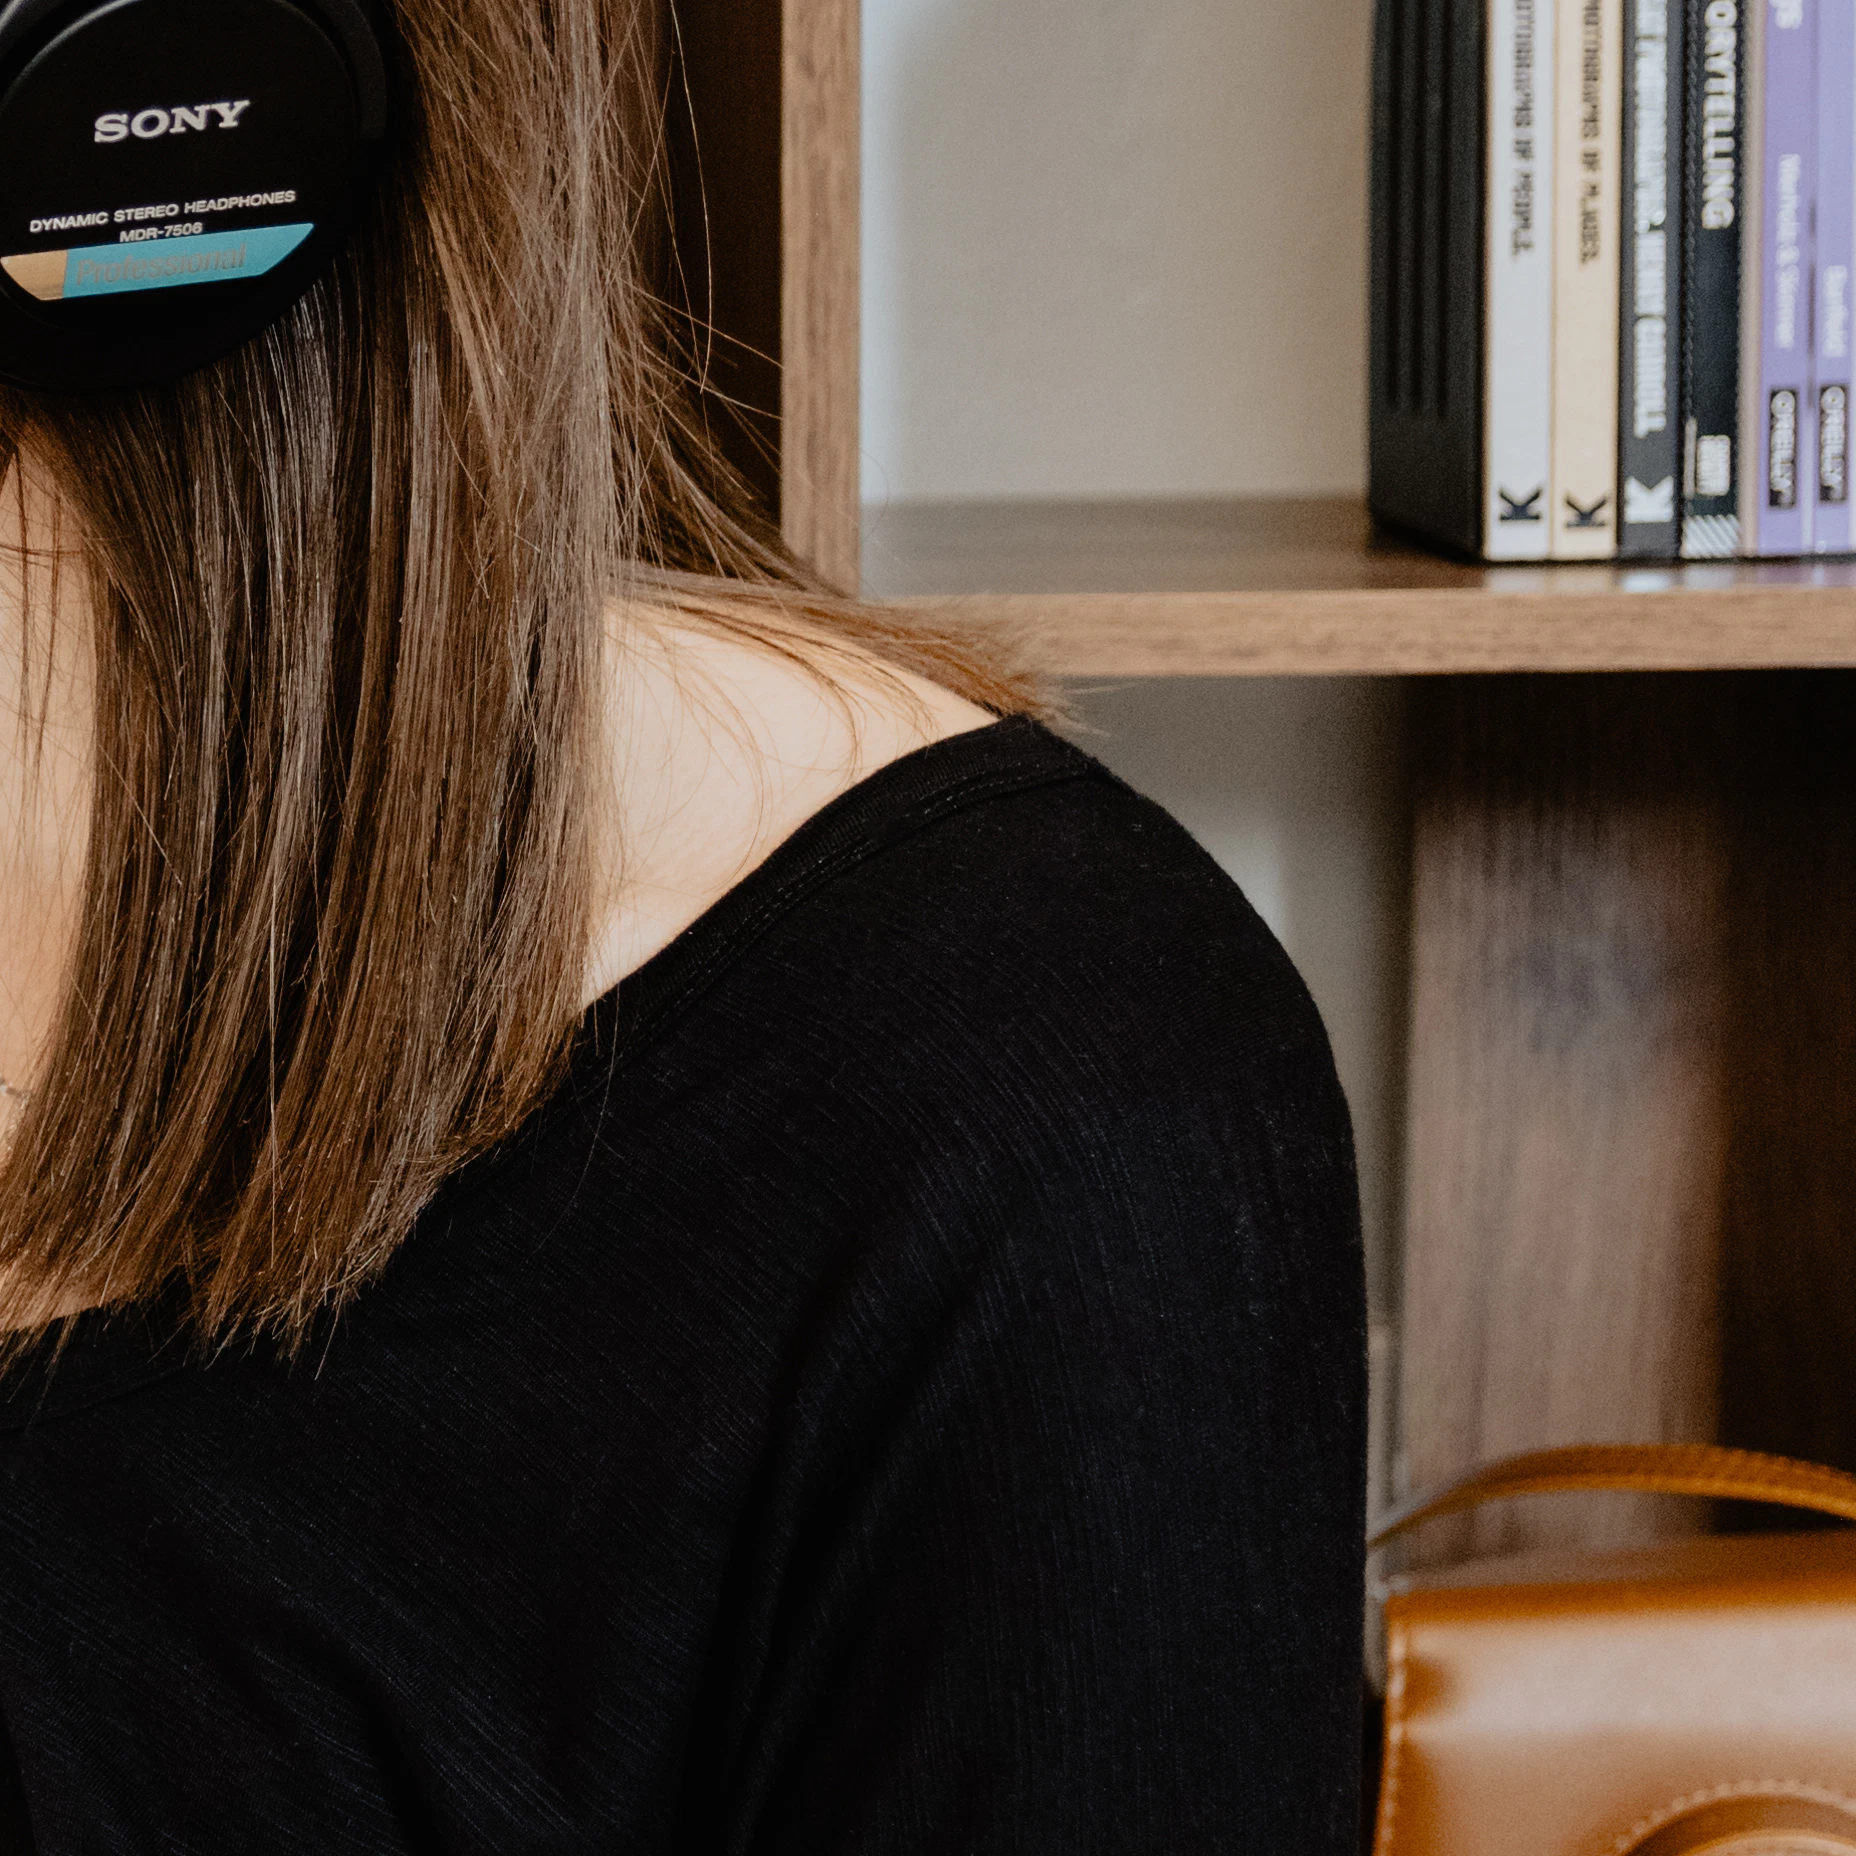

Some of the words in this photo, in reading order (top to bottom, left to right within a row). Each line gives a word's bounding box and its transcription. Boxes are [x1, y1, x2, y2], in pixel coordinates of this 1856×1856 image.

[93, 98, 250, 143] SONY
[29, 211, 109, 234] DYNAMIC
[113, 203, 179, 224] STEREO
[183, 189, 296, 215] HEADPHONES
[119, 221, 203, 244] MDR-7506
[75, 243, 249, 286] Professional
[1499, 487, 1543, 522] K
[1565, 494, 1610, 529] K
[1625, 477, 1674, 523] K
